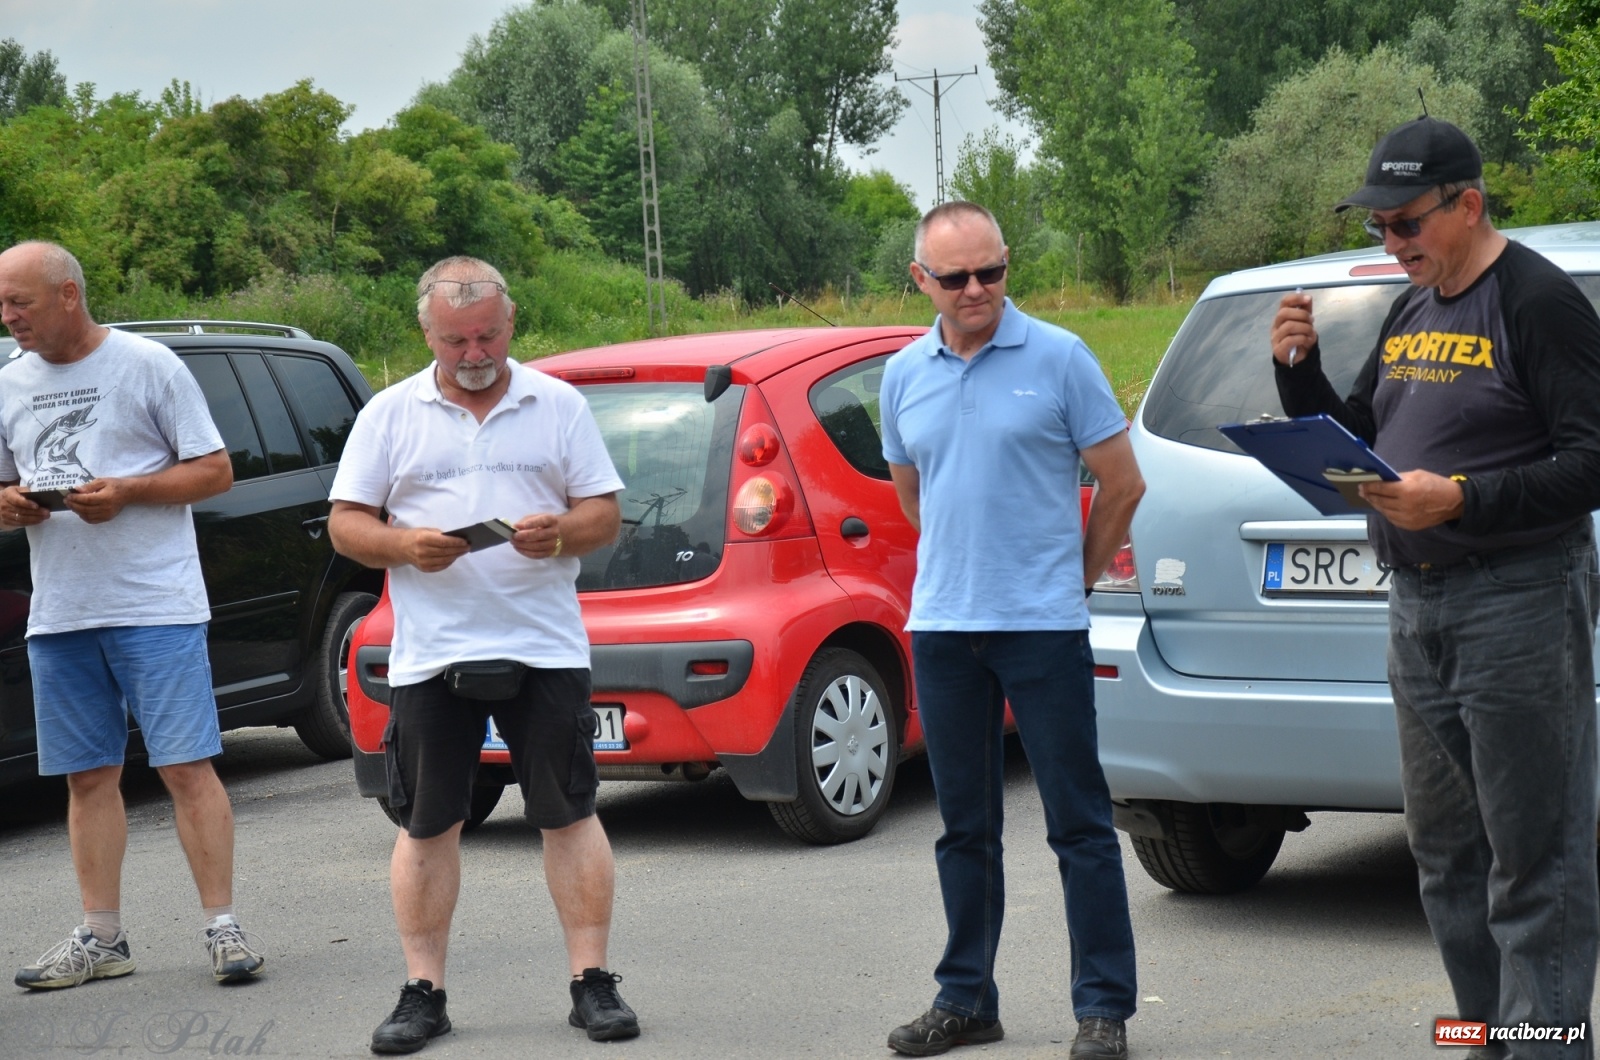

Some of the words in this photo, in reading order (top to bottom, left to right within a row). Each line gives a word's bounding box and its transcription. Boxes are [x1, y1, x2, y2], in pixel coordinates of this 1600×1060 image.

[1381, 162, 1423, 171] SPORTEX
[1382, 331, 1494, 369] SPORTEX
[1385, 365, 1462, 383] GERMANY
[32, 391, 69, 402] WSZYSCY
[70, 387, 99, 397] LUDZIE
[458, 464, 484, 476] leszcz
[36, 474, 49, 482] ALE
[37, 479, 76, 488] NAJLEPSI
[675, 551, 694, 562] 10
[1291, 547, 1360, 586] SRC
[1268, 571, 1280, 582] PL
[1151, 586, 1186, 596] TOYOTA
